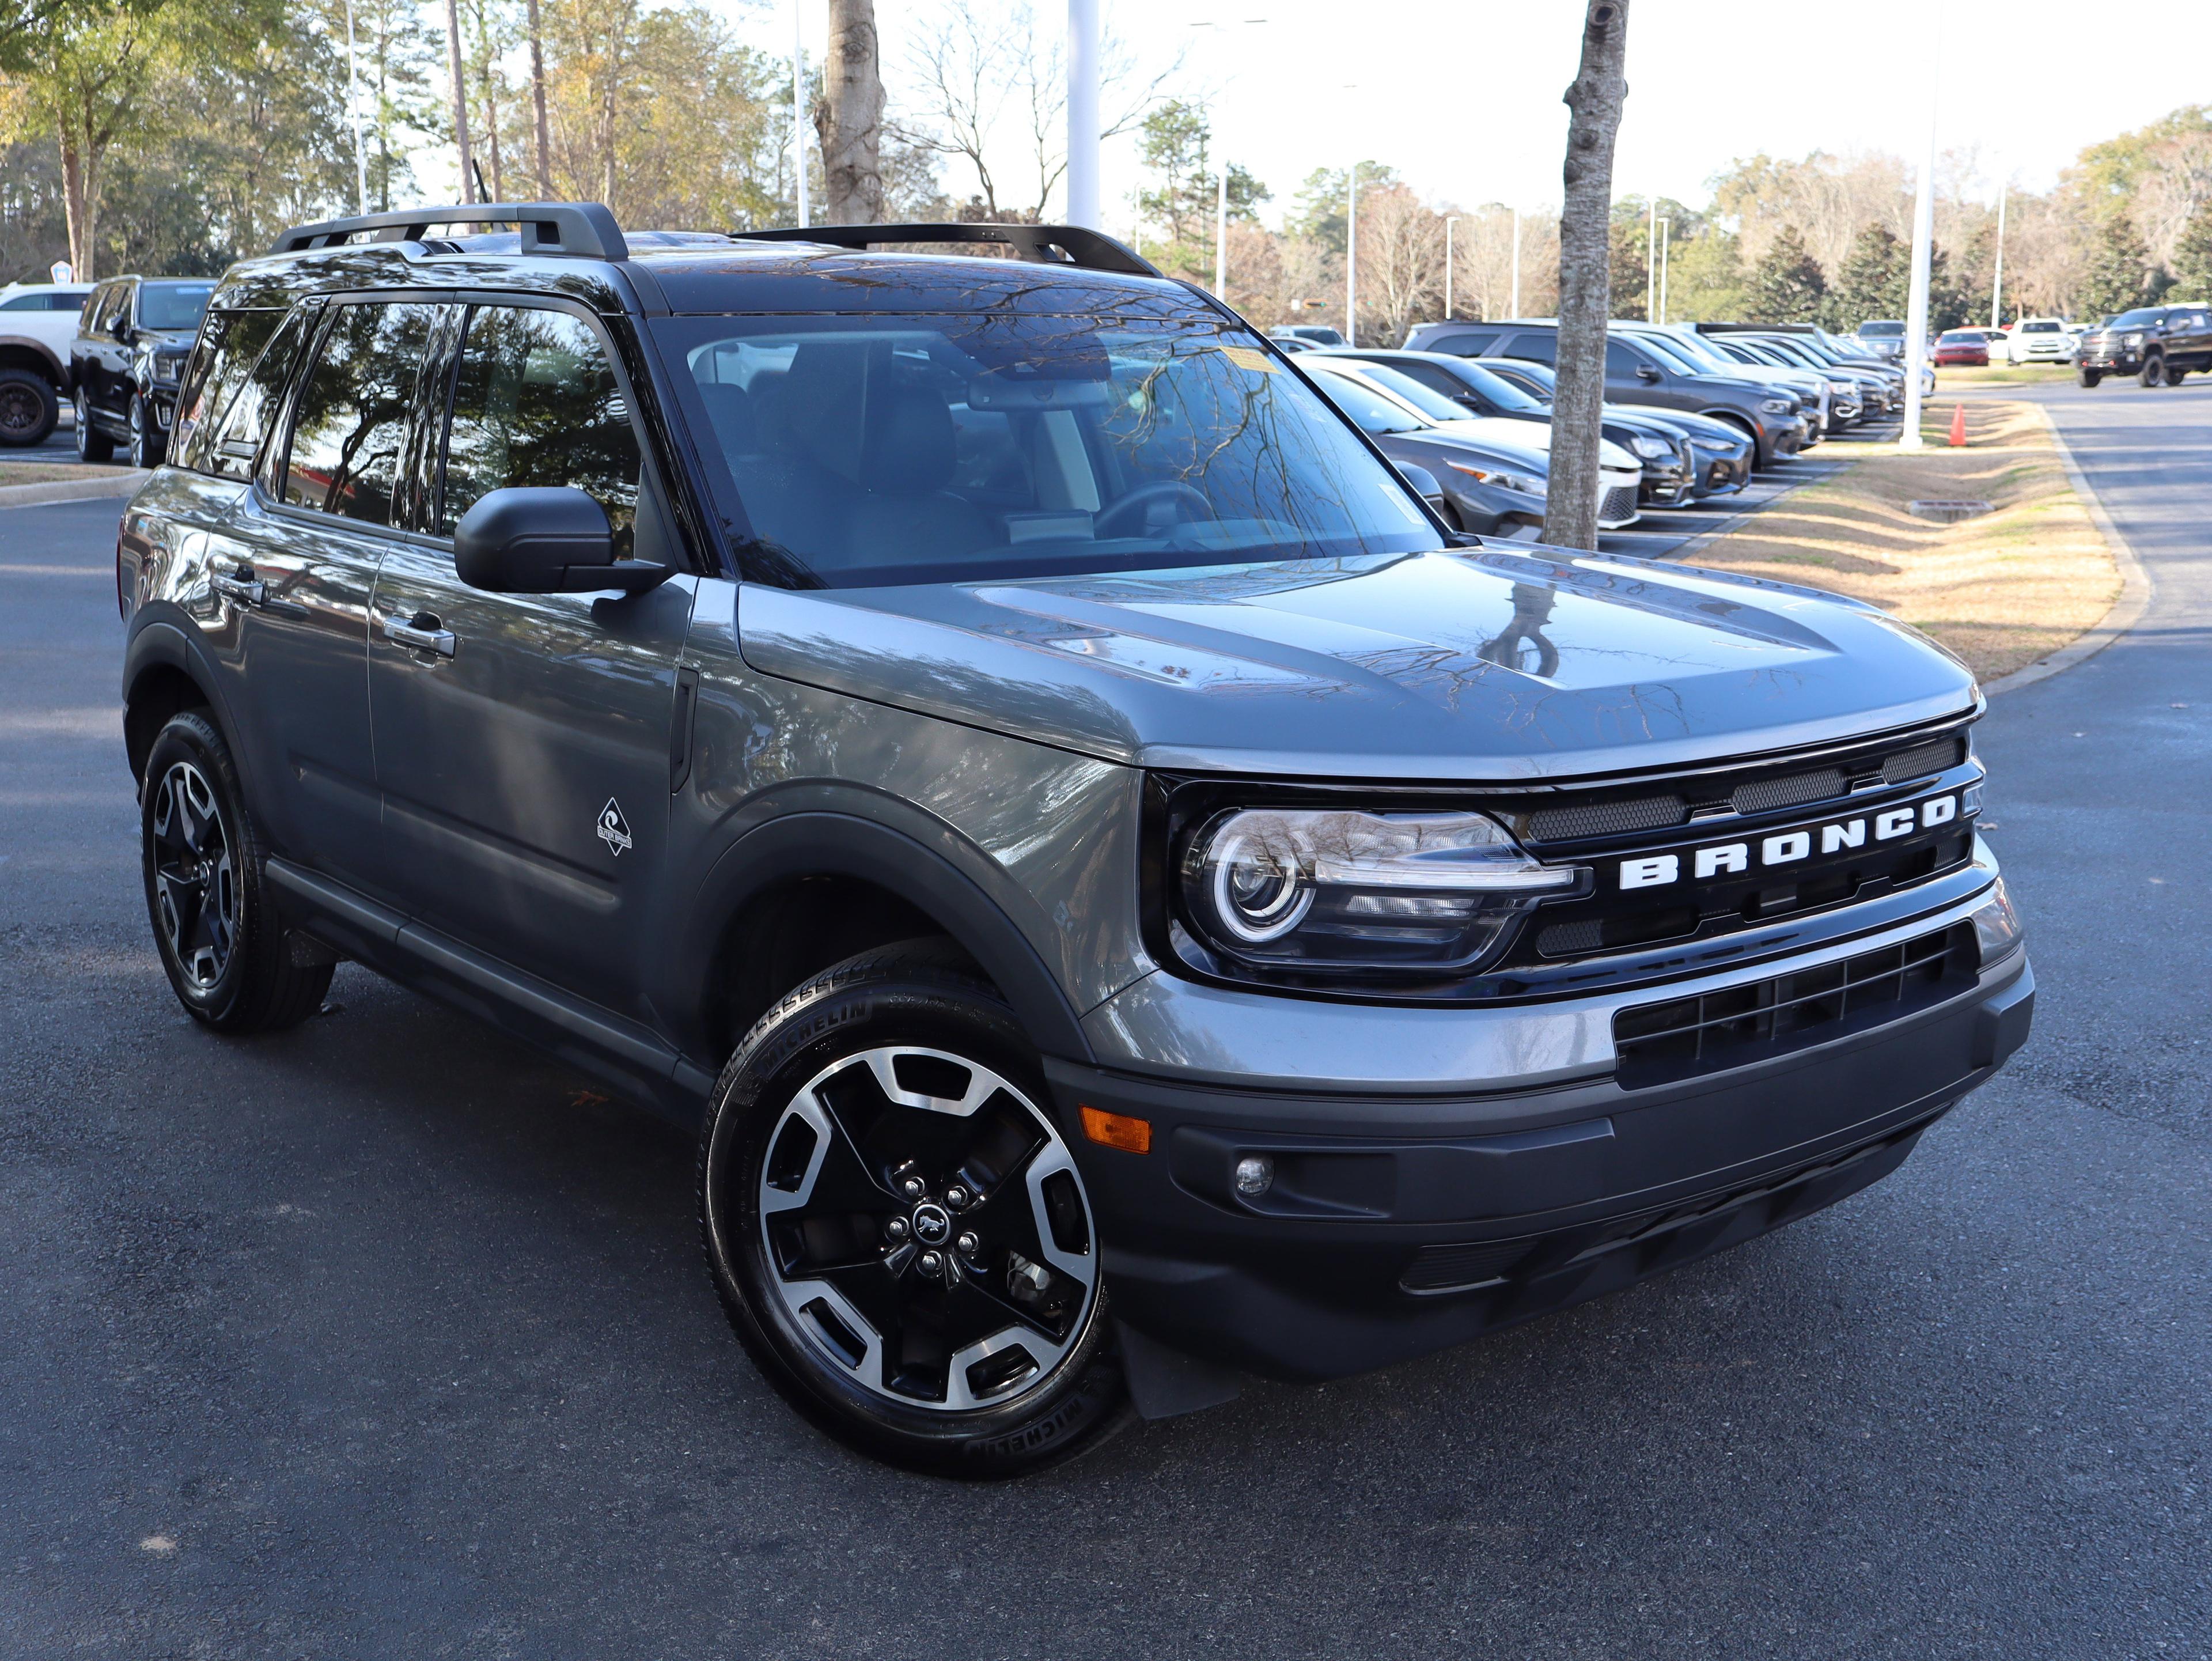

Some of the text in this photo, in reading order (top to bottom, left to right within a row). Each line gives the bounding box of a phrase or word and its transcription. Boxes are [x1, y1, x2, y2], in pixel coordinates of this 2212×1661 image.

[599, 829, 630, 845] OUTER BANKS
[1619, 795, 1956, 890] BRONCO
[764, 1002, 866, 1071] MICHELIN
[970, 1398, 1084, 1456] MICHELIN
